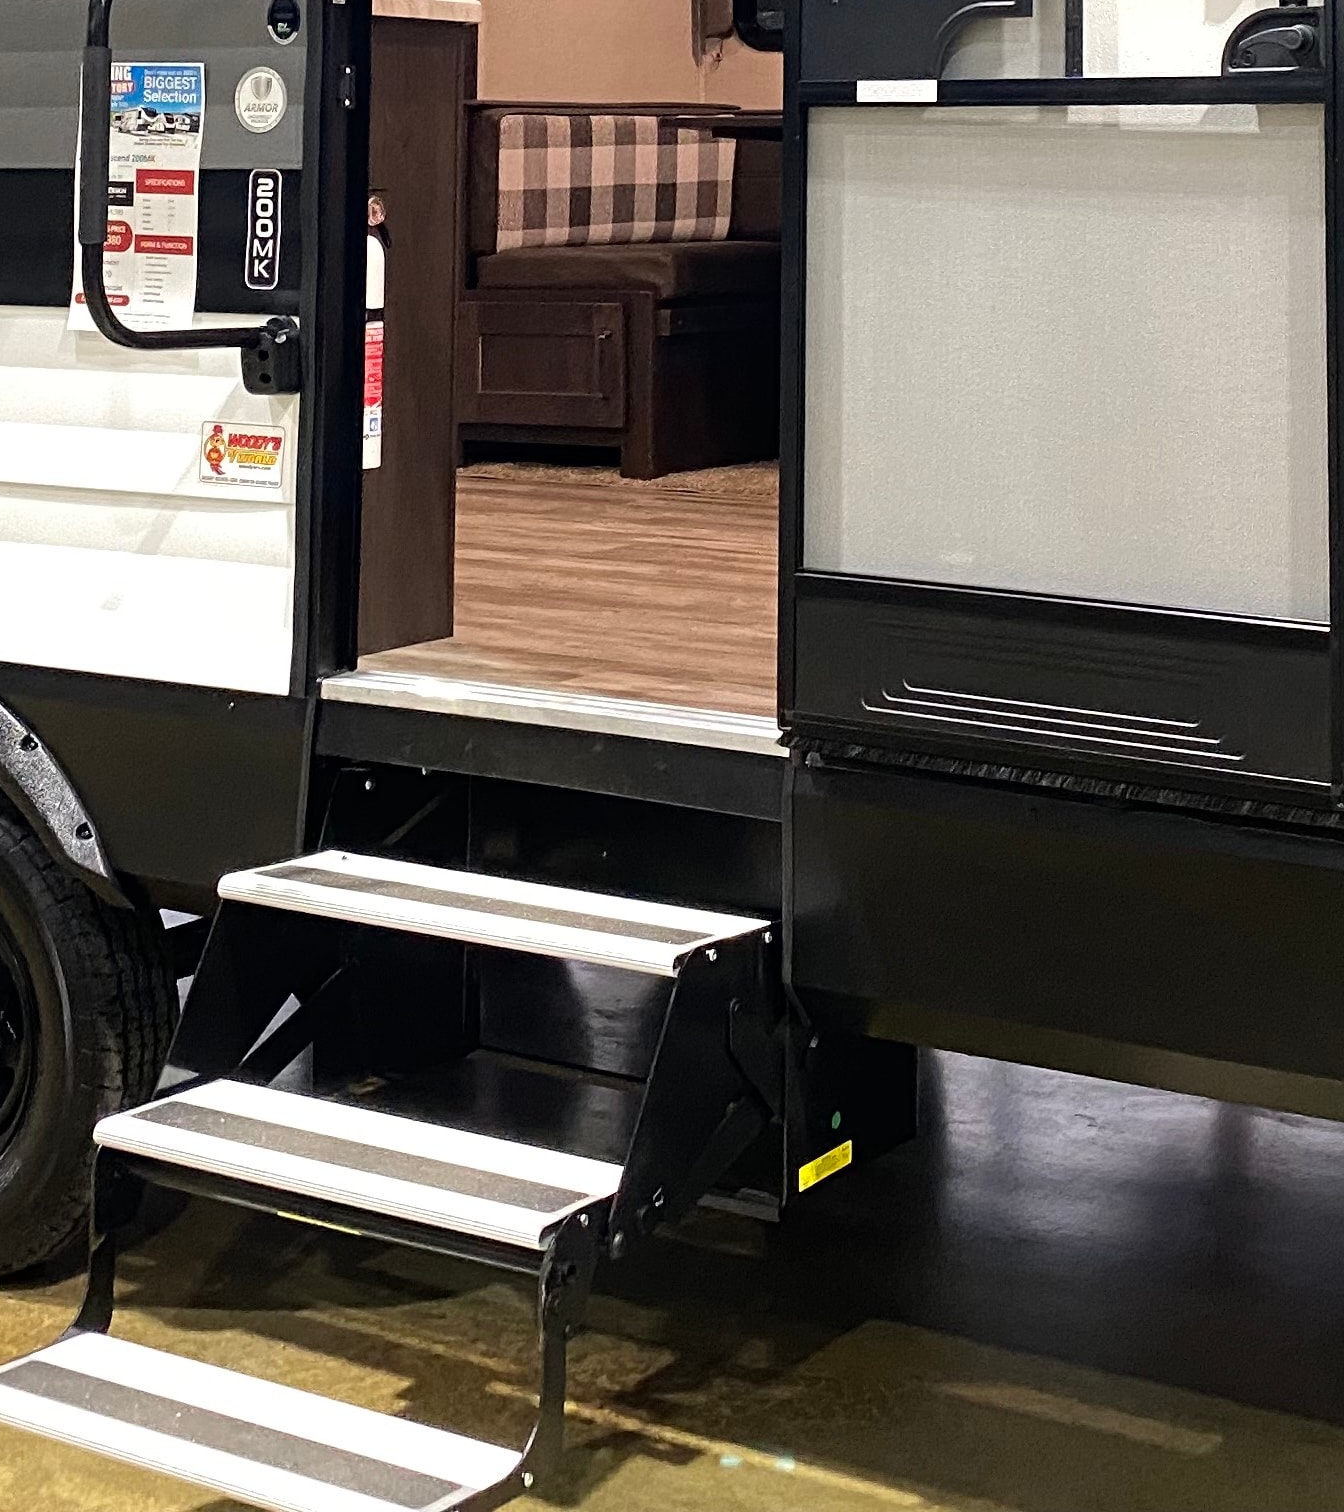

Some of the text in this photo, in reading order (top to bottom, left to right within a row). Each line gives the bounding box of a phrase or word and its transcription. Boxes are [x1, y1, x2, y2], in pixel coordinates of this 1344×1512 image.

[143, 76, 197, 90] BIGGEST
[143, 89, 197, 104] Selection
[243, 103, 279, 113] ARMOR
[252, 177, 274, 279] 200MK
